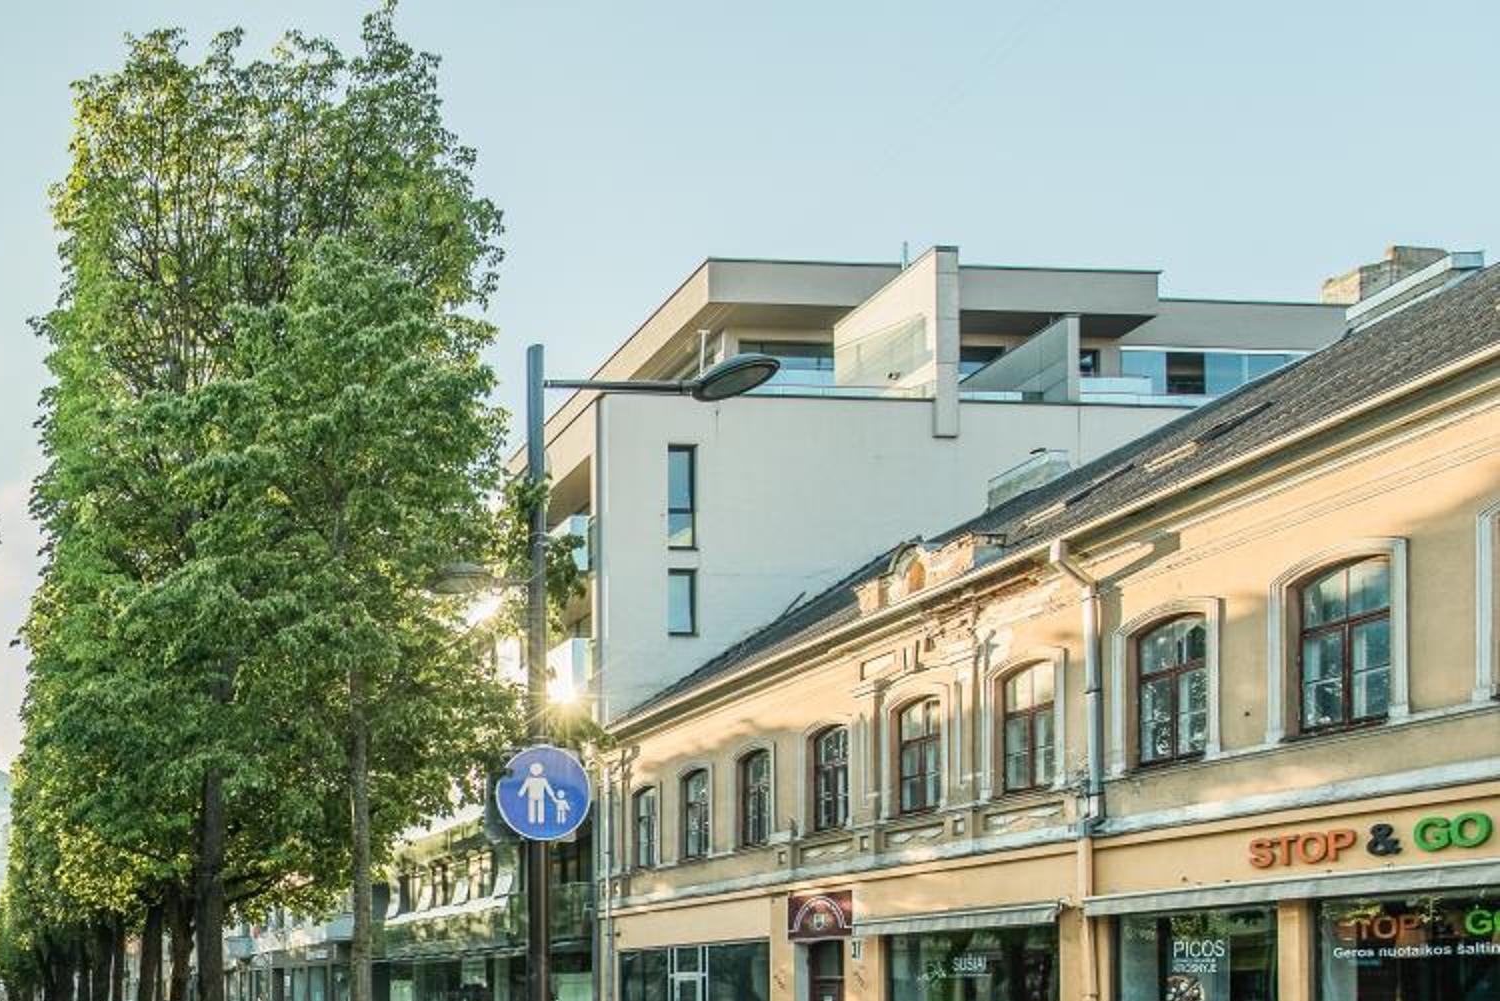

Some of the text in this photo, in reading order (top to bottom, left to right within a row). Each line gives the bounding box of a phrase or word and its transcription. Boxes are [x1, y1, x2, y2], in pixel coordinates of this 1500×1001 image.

[1250, 812, 1493, 870] STOP & GO
[1465, 909, 1500, 935] G
[1173, 940, 1226, 958] PICOS
[1333, 946, 1375, 958] Geros
[1379, 943, 1452, 958] nuotaikos
